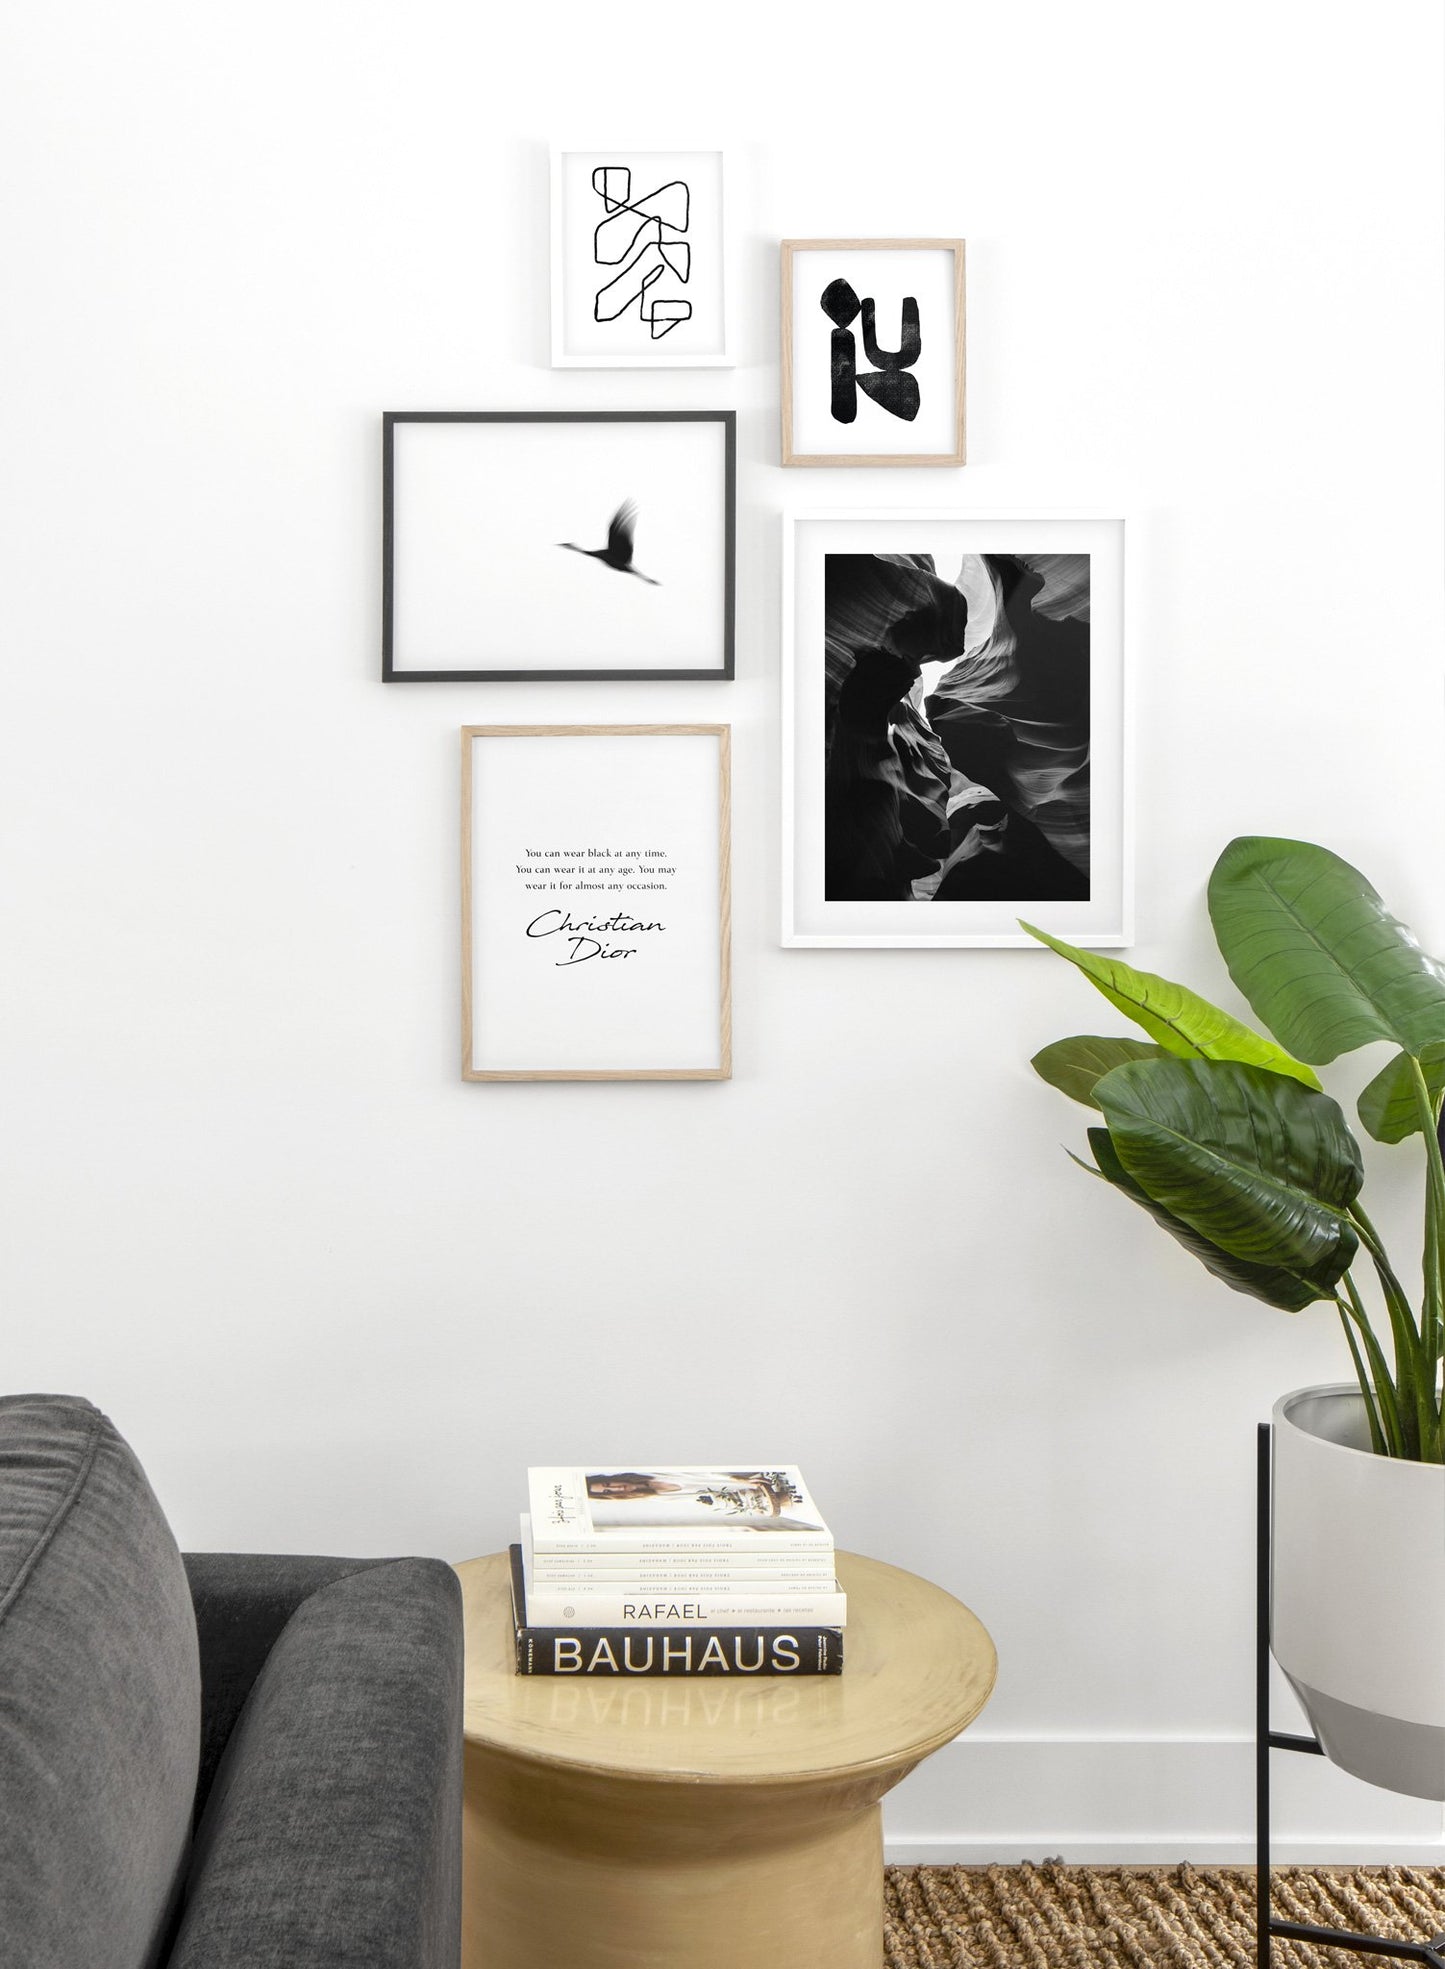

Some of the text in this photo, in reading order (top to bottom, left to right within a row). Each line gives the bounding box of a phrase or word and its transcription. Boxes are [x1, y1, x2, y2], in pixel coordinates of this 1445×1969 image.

[525, 848, 542, 858] You
[588, 848, 612, 858] black
[614, 850, 623, 858] at
[625, 851, 642, 860] any
[644, 849, 667, 858] time.
[515, 864, 532, 874] You
[578, 865, 585, 874] it
[587, 866, 596, 874] at
[599, 867, 615, 876] any
[618, 867, 635, 876] age.
[638, 864, 655, 874] You
[657, 867, 677, 876] may
[549, 881, 556, 890] it
[559, 880, 573, 890] for
[575, 880, 605, 890] almost
[607, 883, 624, 892] any
[626, 881, 668, 890] occasion.
[525, 909, 667, 938] Christian
[555, 936, 637, 966] Dior
[623, 1603, 707, 1619] RAFAEL
[554, 1634, 800, 1673] BAUHAUS
